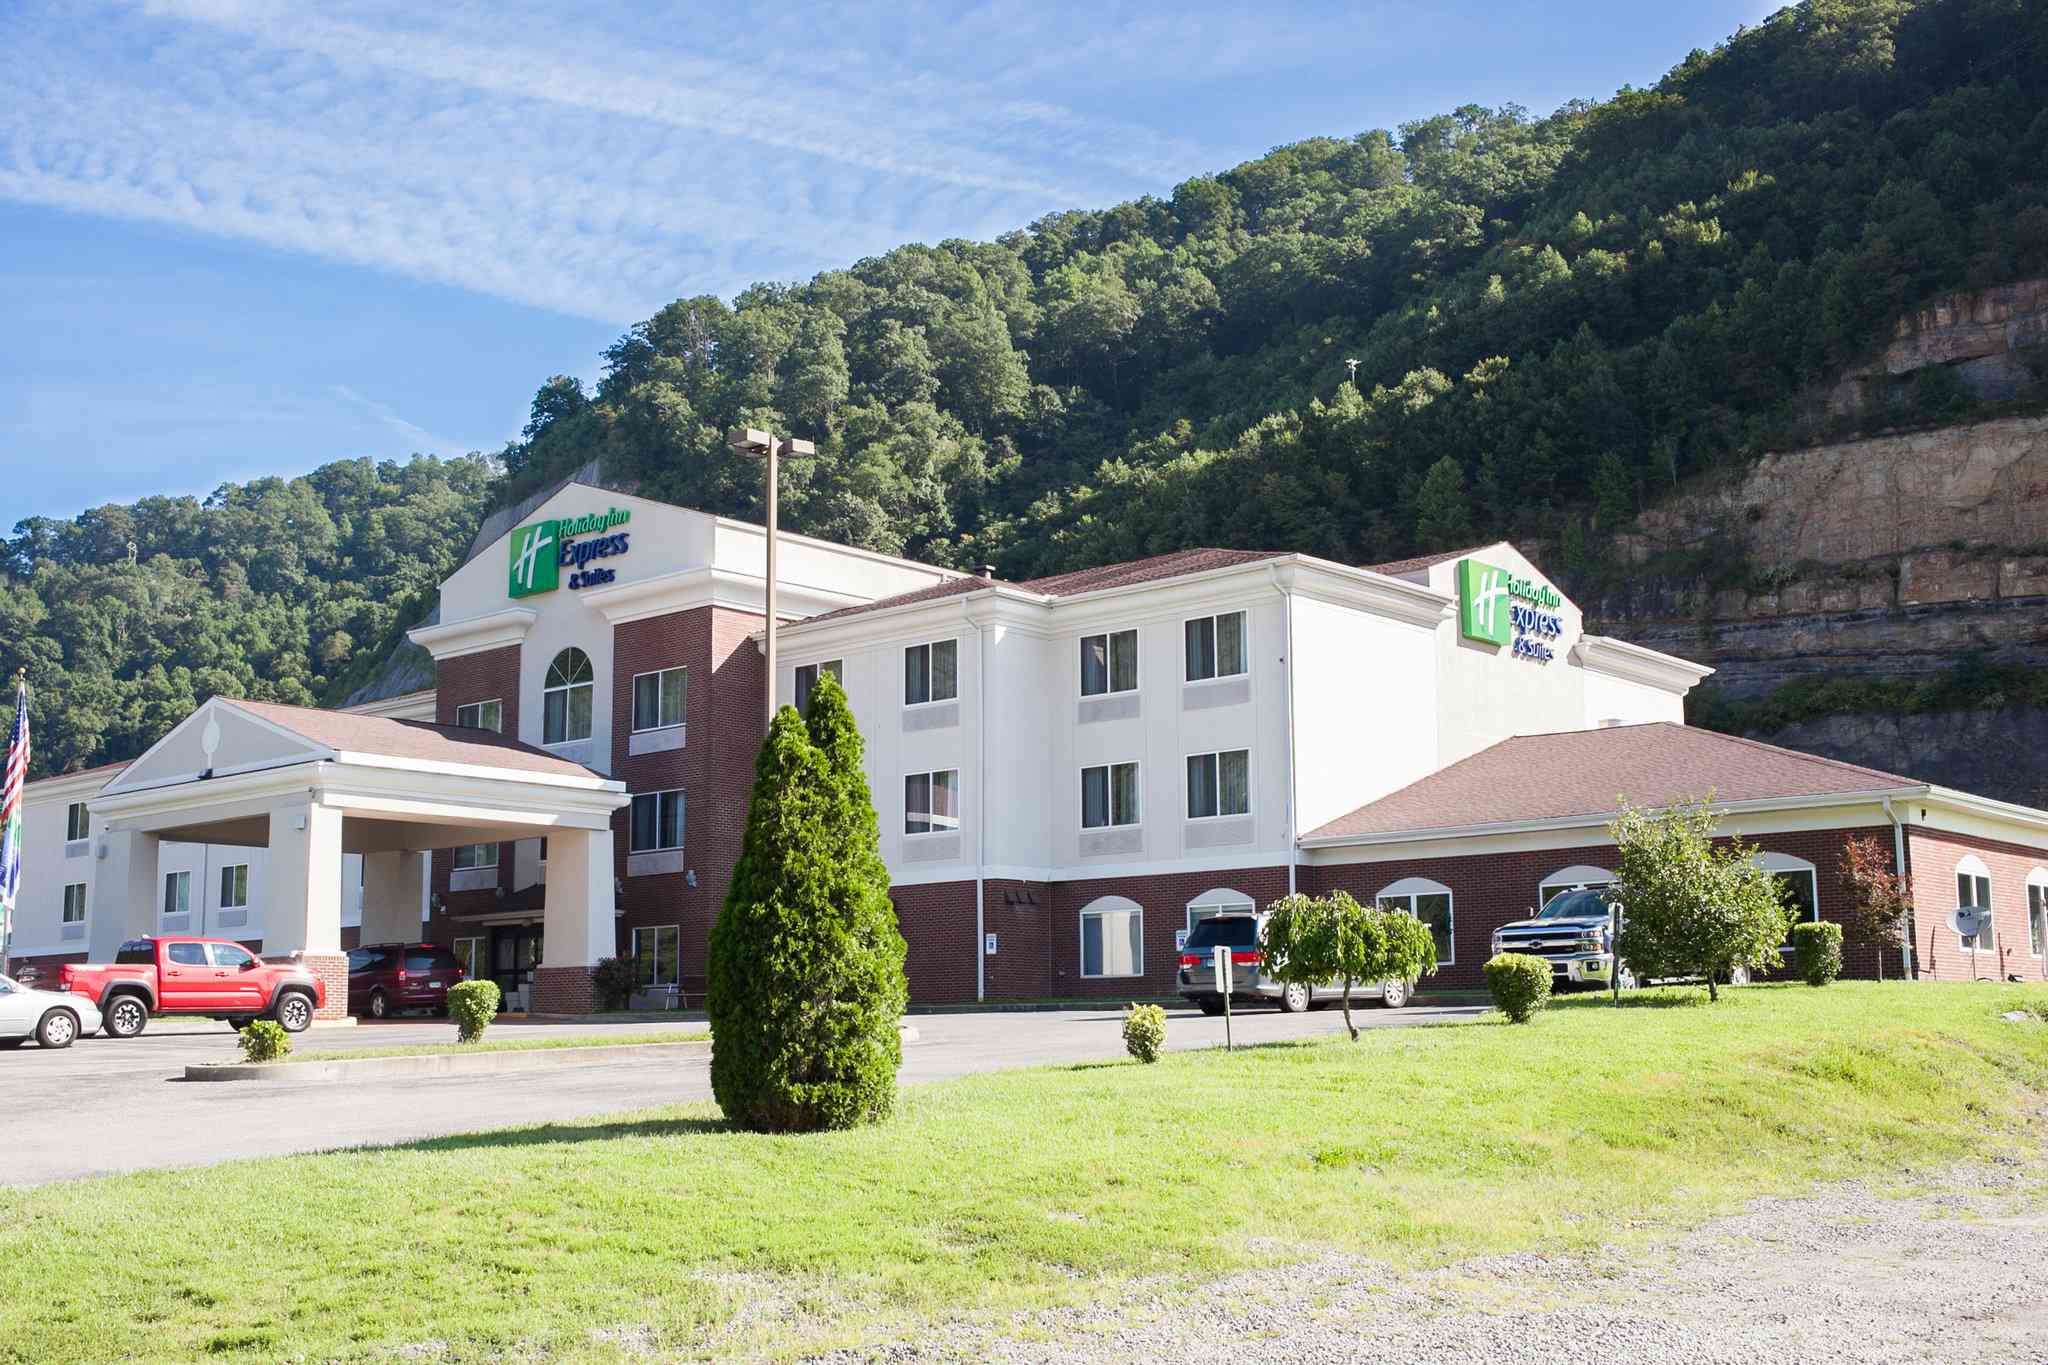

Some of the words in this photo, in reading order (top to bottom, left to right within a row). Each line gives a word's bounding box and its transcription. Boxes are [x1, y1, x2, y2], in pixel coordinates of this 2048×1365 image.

[559, 513, 608, 538] Holiday
[606, 507, 630, 527] Inn
[559, 533, 629, 569] Express
[569, 573, 580, 590] &
[580, 568, 616, 587] Suites
